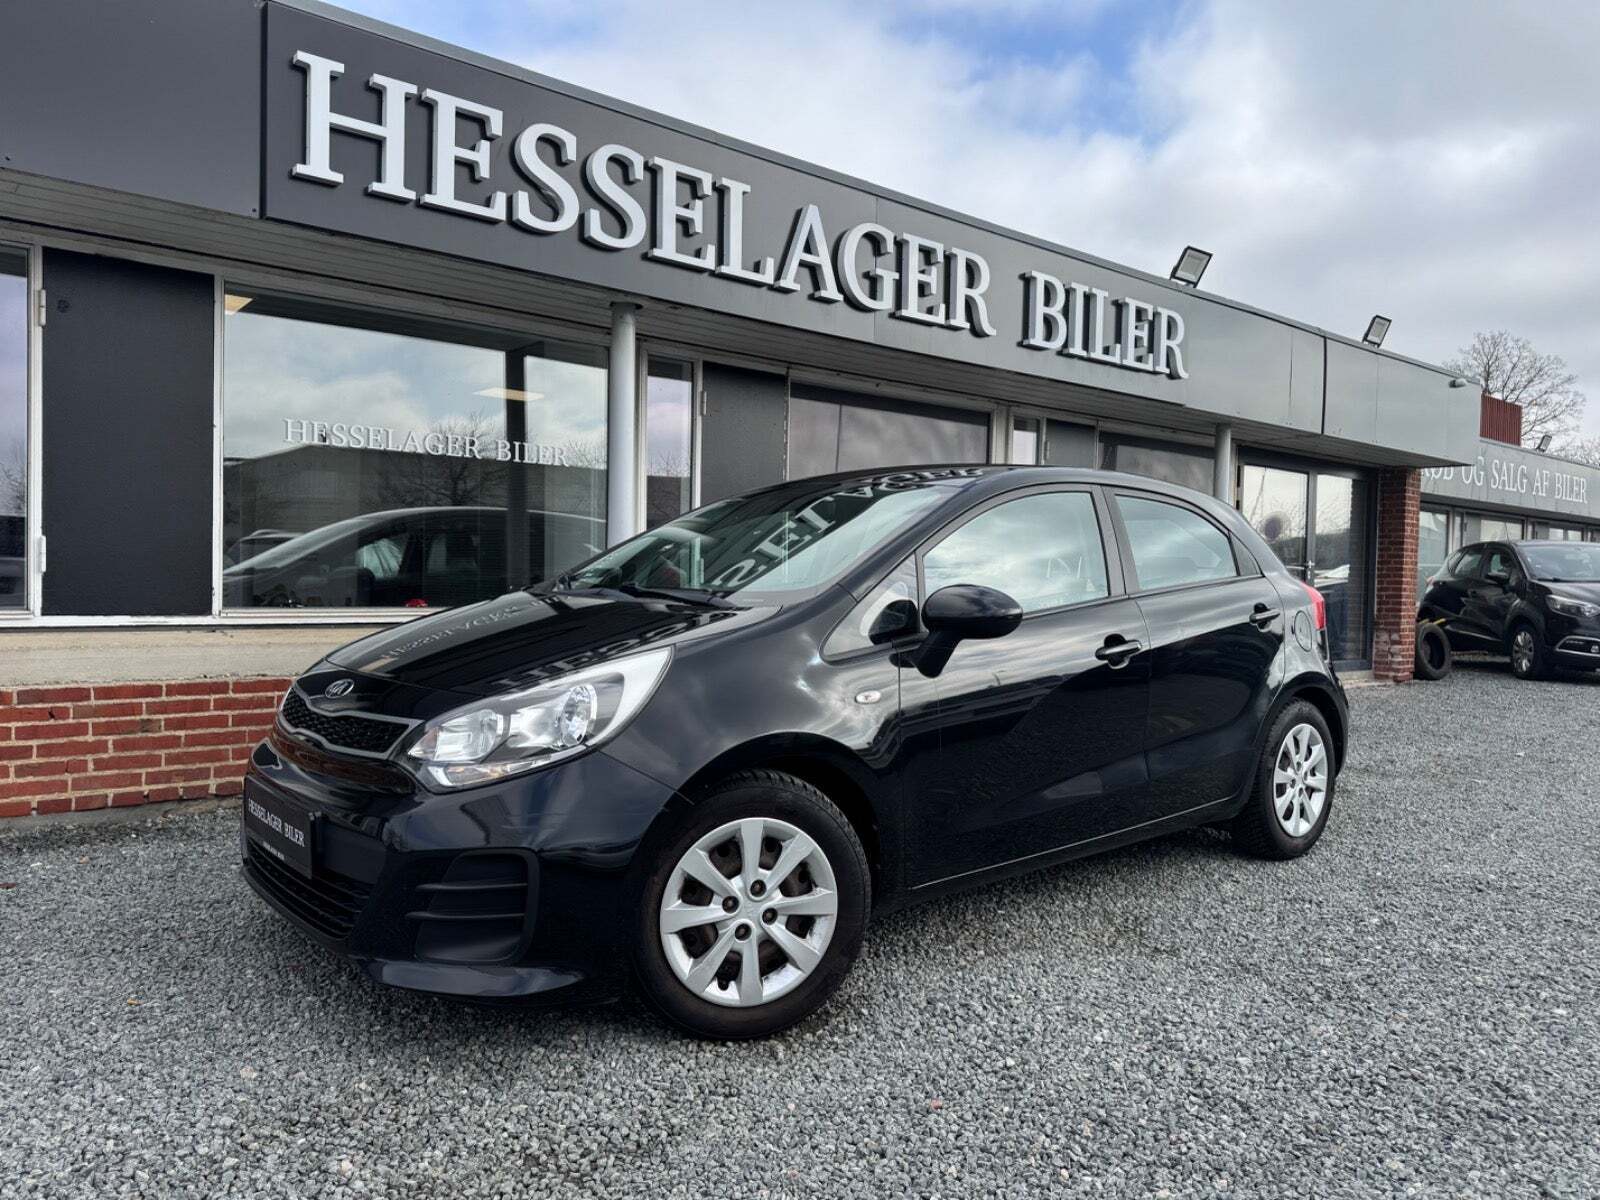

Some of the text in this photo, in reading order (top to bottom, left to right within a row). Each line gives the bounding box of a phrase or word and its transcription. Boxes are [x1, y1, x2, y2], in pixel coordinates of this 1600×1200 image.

[291, 49, 1190, 380] HESSELAGER BILER
[283, 418, 570, 468] HESSELAGER BILER
[1461, 455, 1485, 487] OG
[1490, 459, 1528, 494] SALG
[1532, 468, 1550, 498] AF
[1554, 472, 1588, 504] BILER
[284, 821, 306, 849] BILER
